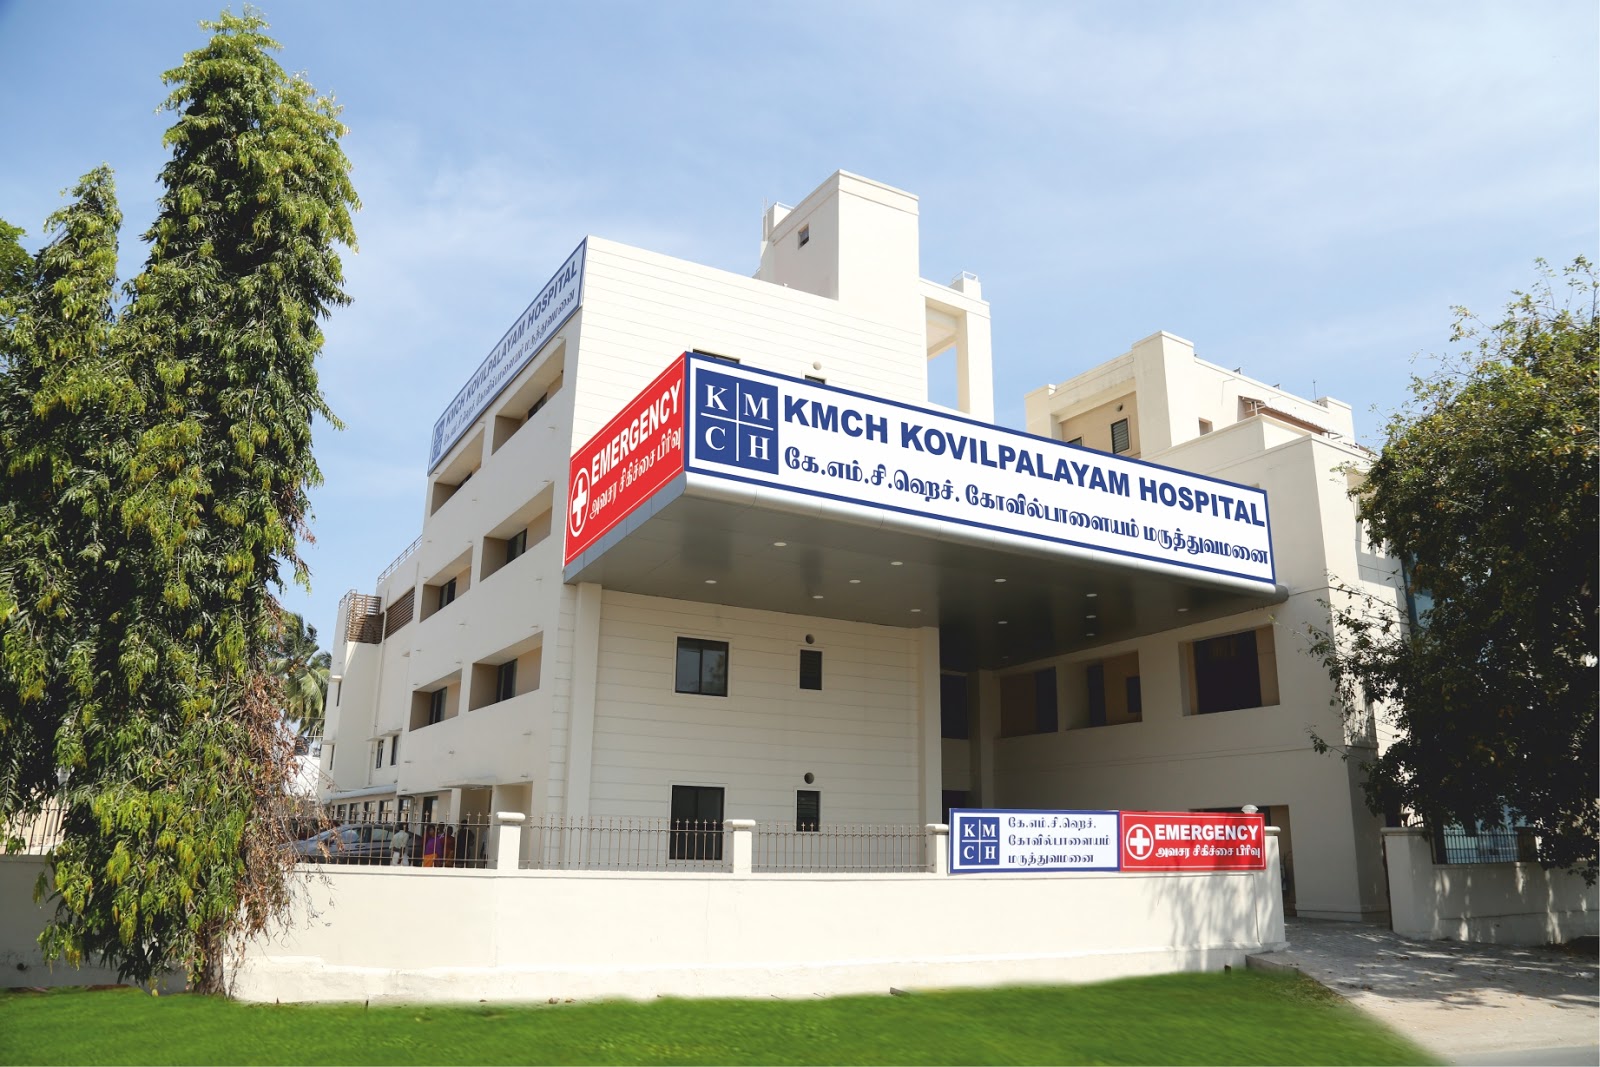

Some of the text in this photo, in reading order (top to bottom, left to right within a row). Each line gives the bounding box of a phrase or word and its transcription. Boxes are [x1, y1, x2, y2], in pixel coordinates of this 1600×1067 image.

[446, 393, 466, 427] KMCH
[466, 320, 525, 402] KOVILPALAYAM
[527, 260, 577, 330] HOSPITAL
[589, 427, 682, 520] அவசர சிகிச்சை பிரிவு
[591, 379, 682, 486] EMERGENCY
[784, 394, 1265, 527] KMCH KOVILPALAYAM HOSPITAL
[784, 446, 1268, 565] கே.எம்.சி.ஹெச். கோவில்பாளையம் மருத்துவமனை
[1008, 834, 1110, 846] கோவில்பாளையம்
[1008, 852, 1094, 866] மருத்துவமனை
[1154, 824, 1259, 841] EMERGENCY
[1155, 844, 1261, 859] அவசர சிகிச்சை பிரிவு
